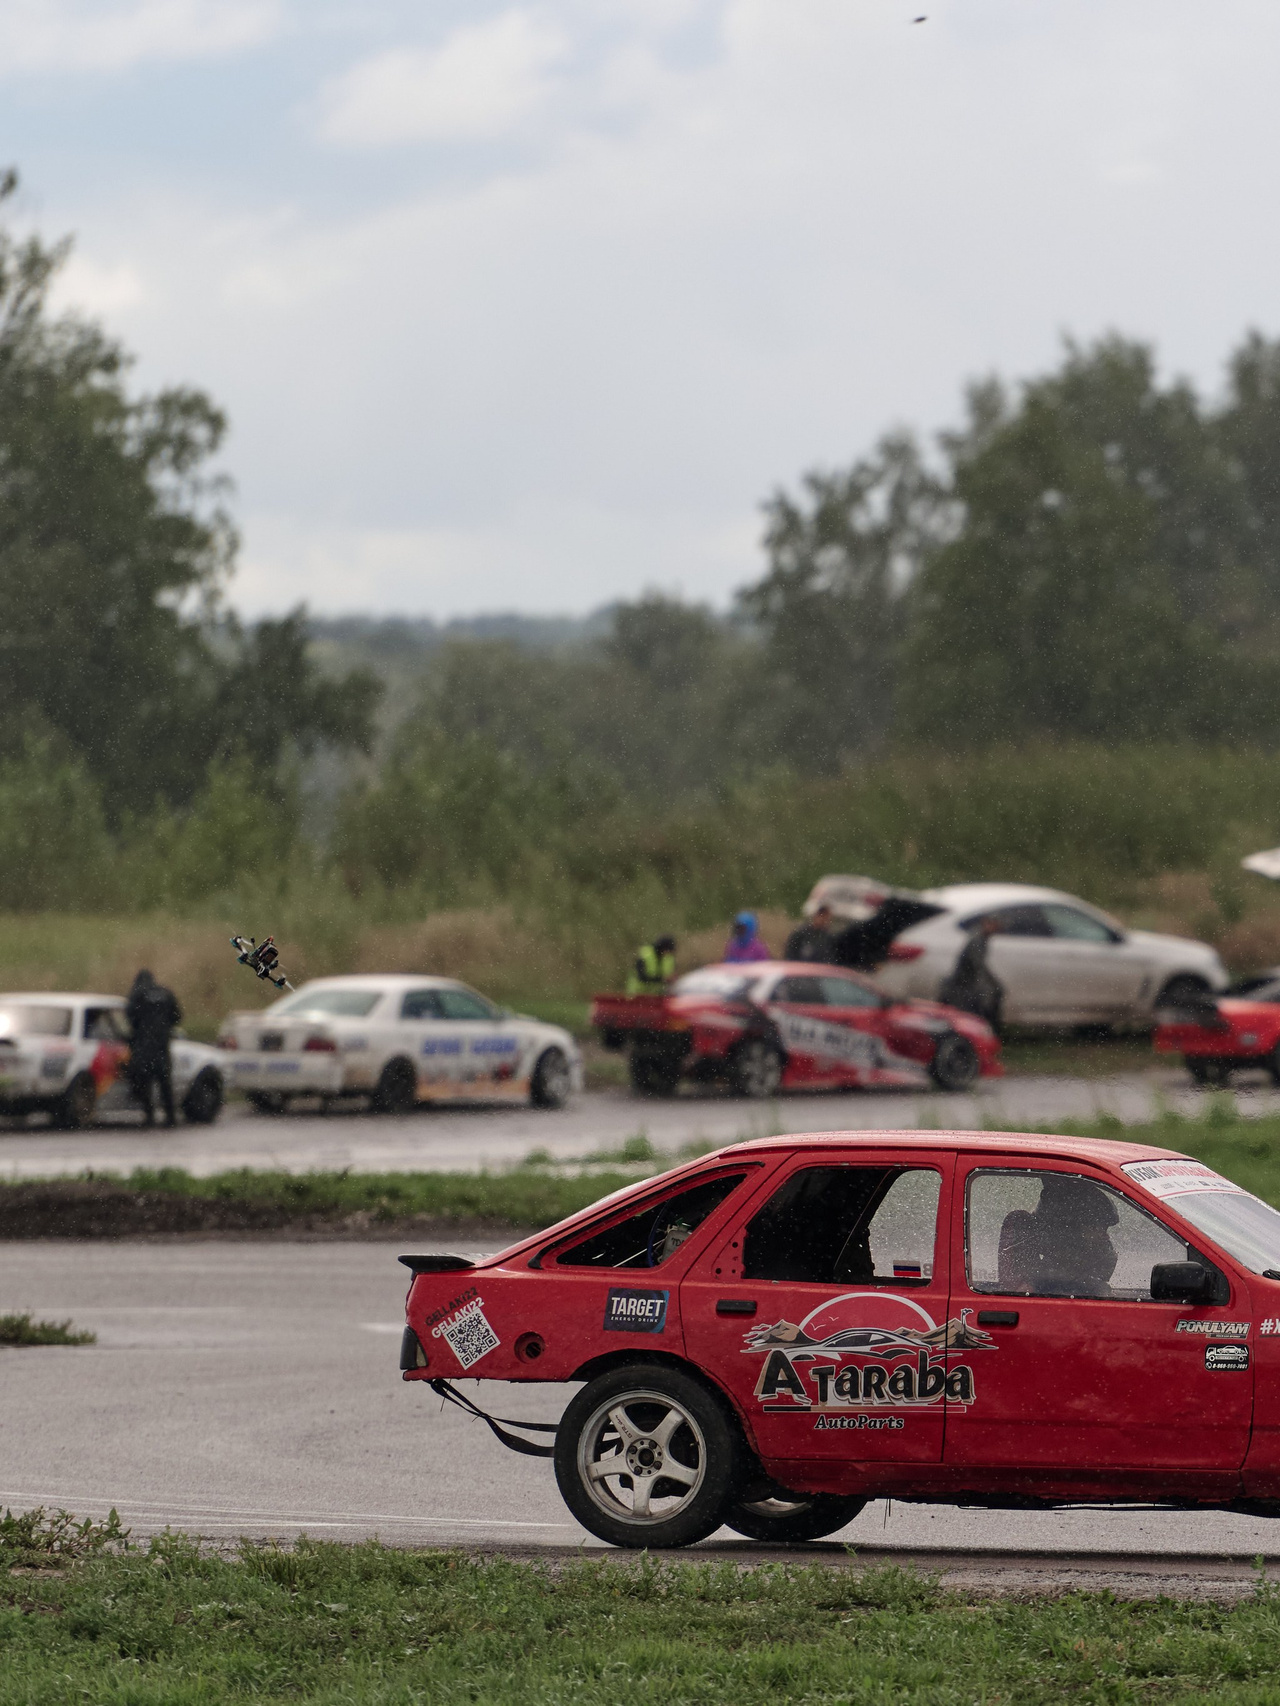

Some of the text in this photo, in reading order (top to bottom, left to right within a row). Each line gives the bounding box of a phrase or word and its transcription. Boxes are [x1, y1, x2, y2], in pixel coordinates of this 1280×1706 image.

[425, 1287, 478, 1326] GELLAKI22
[611, 1297, 664, 1317] TARGET
[431, 1297, 485, 1338] GELLAKI22
[1176, 1320, 1251, 1334] PONULYAM
[814, 1414, 904, 1430] AutoParts
